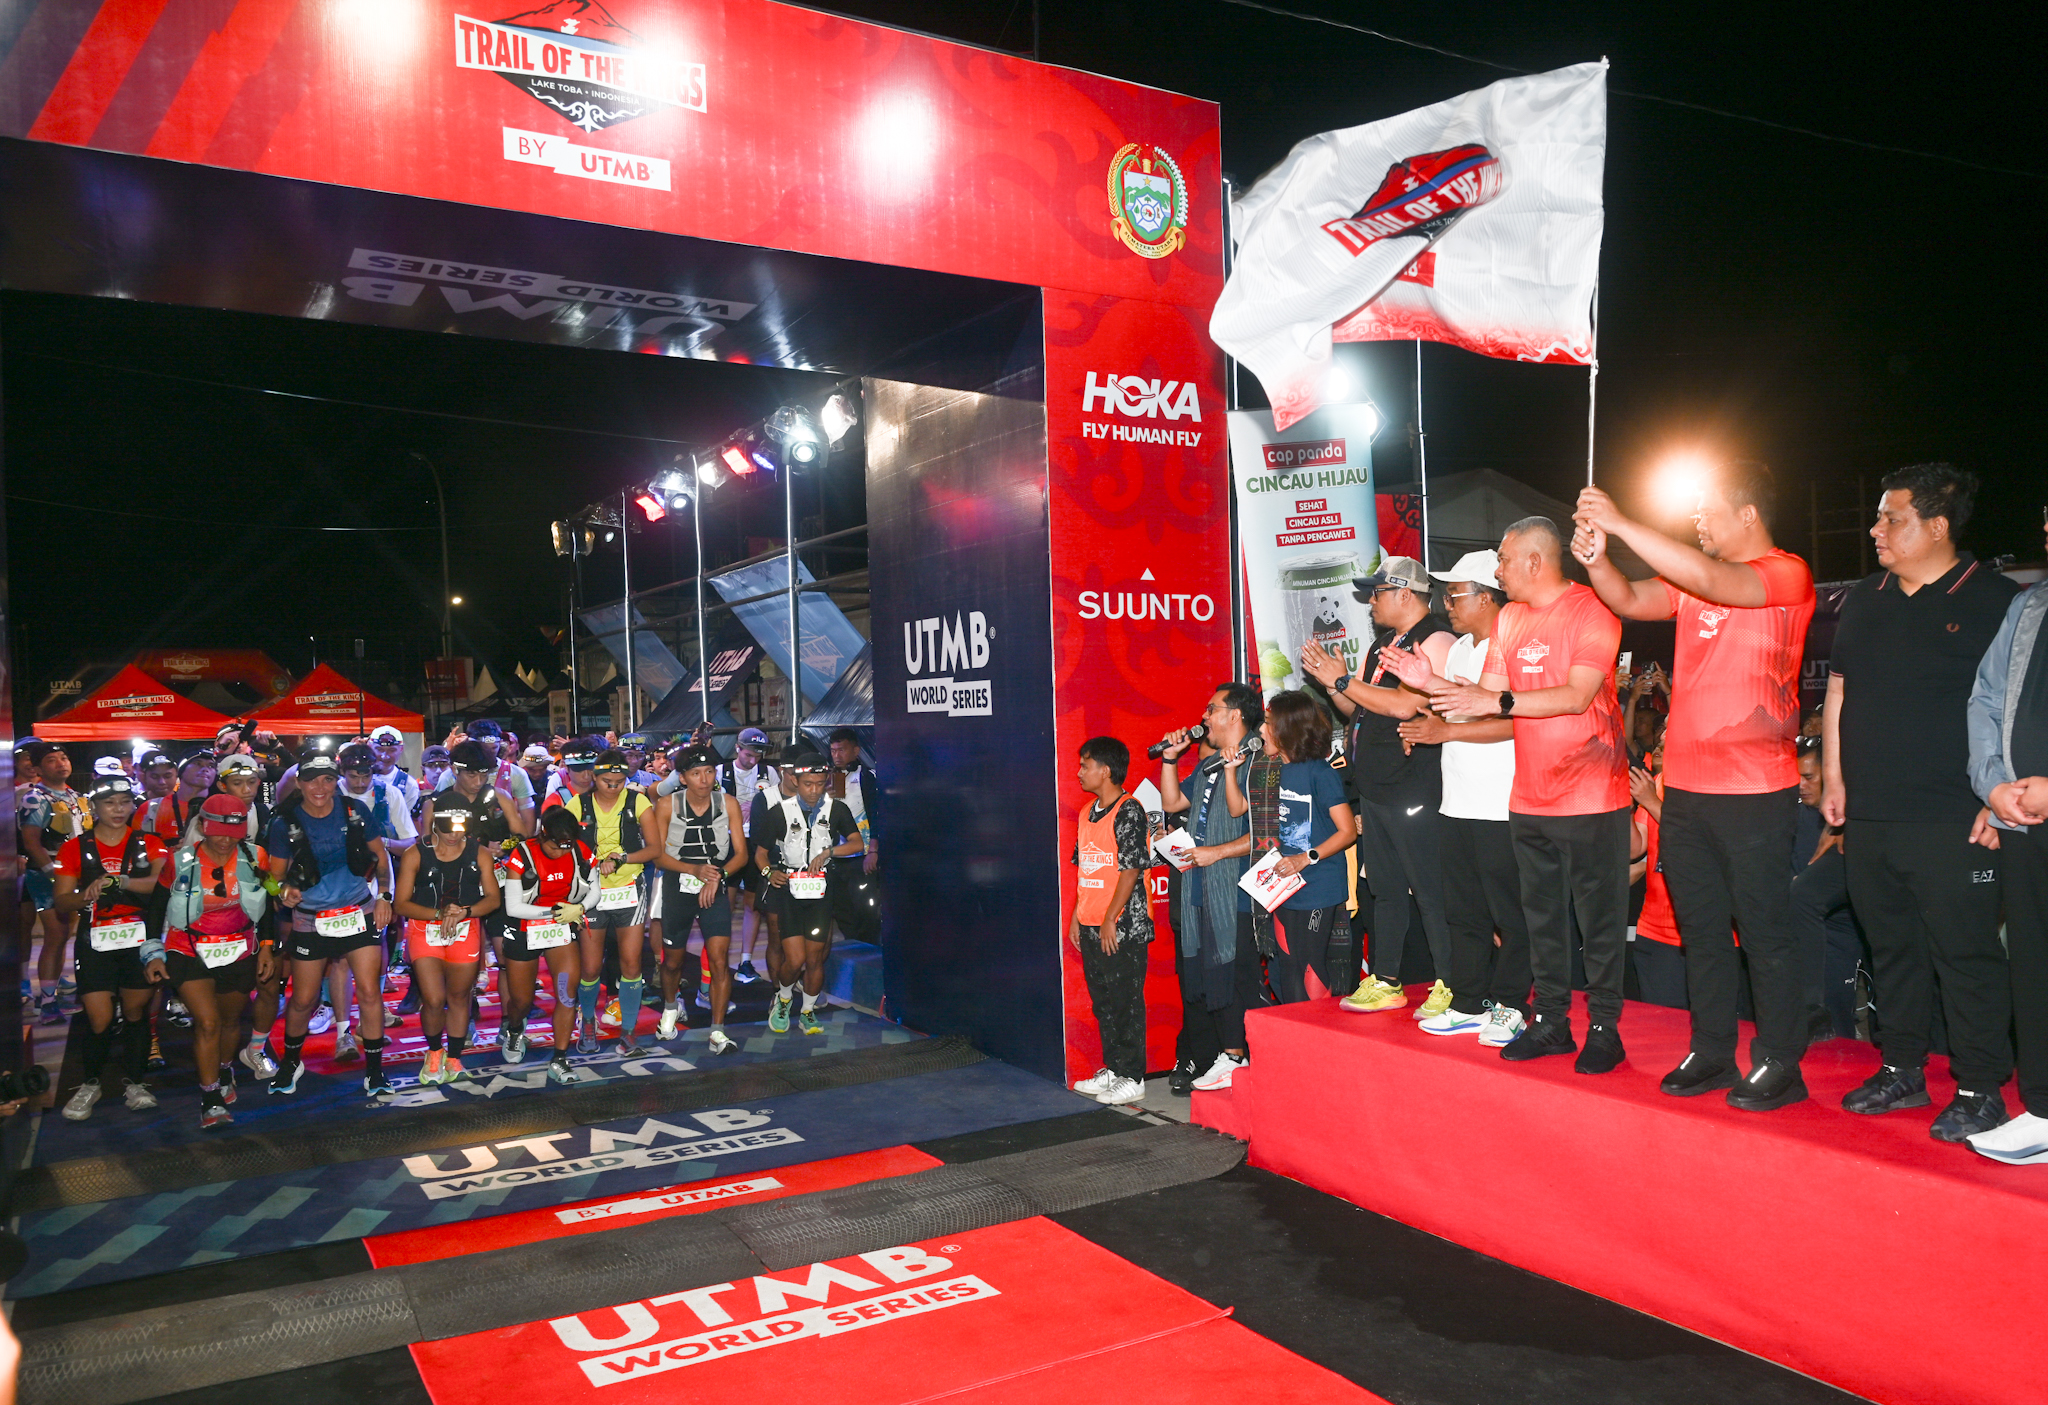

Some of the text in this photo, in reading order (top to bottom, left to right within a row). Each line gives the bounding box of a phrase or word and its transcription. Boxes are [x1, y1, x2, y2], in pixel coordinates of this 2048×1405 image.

[459, 19, 535, 72] TRAIL
[541, 43, 573, 76] OF
[580, 52, 626, 88] THE
[531, 78, 641, 105] LAKE TOBA INDONESIA
[519, 136, 651, 182] BY UTMB
[1326, 212, 1415, 249] TRAIL
[1404, 195, 1443, 220] OF
[1436, 170, 1478, 204] THE
[367, 254, 731, 318] WORLD SERIES
[341, 275, 727, 339] UTMB
[1082, 371, 1202, 423] HOKA
[1082, 422, 1202, 448] FLY HUMAN FLY
[1267, 442, 1343, 466] cap panda
[1246, 467, 1369, 495] CINCAU HIJAU
[1299, 501, 1324, 512] SEHAT
[1289, 516, 1339, 528] CINCAU ASLI
[1279, 530, 1352, 545] TANPA PENGAWET
[1078, 591, 1215, 622] SUUNTO
[904, 609, 990, 676] UTMB
[1326, 629, 1346, 639] panda
[1802, 660, 1830, 678] UT
[99, 699, 122, 708] TRAIL
[150, 695, 174, 704] KINGS
[910, 685, 989, 710] WORLD SERIES
[751, 735, 766, 744] FILA
[1096, 854, 1113, 865] KINGS
[554, 872, 564, 881] T8
[1973, 869, 1994, 880] EA7
[601, 890, 631, 903] 7027
[794, 882, 822, 892] 7003
[98, 927, 137, 942] 7047
[323, 916, 358, 931] 7008
[534, 927, 564, 941] 7006
[203, 945, 239, 960] 7067
[401, 1108, 772, 1179] UTMB
[441, 1131, 788, 1193] WORLD SERIES
[576, 1184, 755, 1220] BY UTMB
[548, 1245, 954, 1352] UTMB
[600, 1282, 981, 1375] WORLD SERIES
